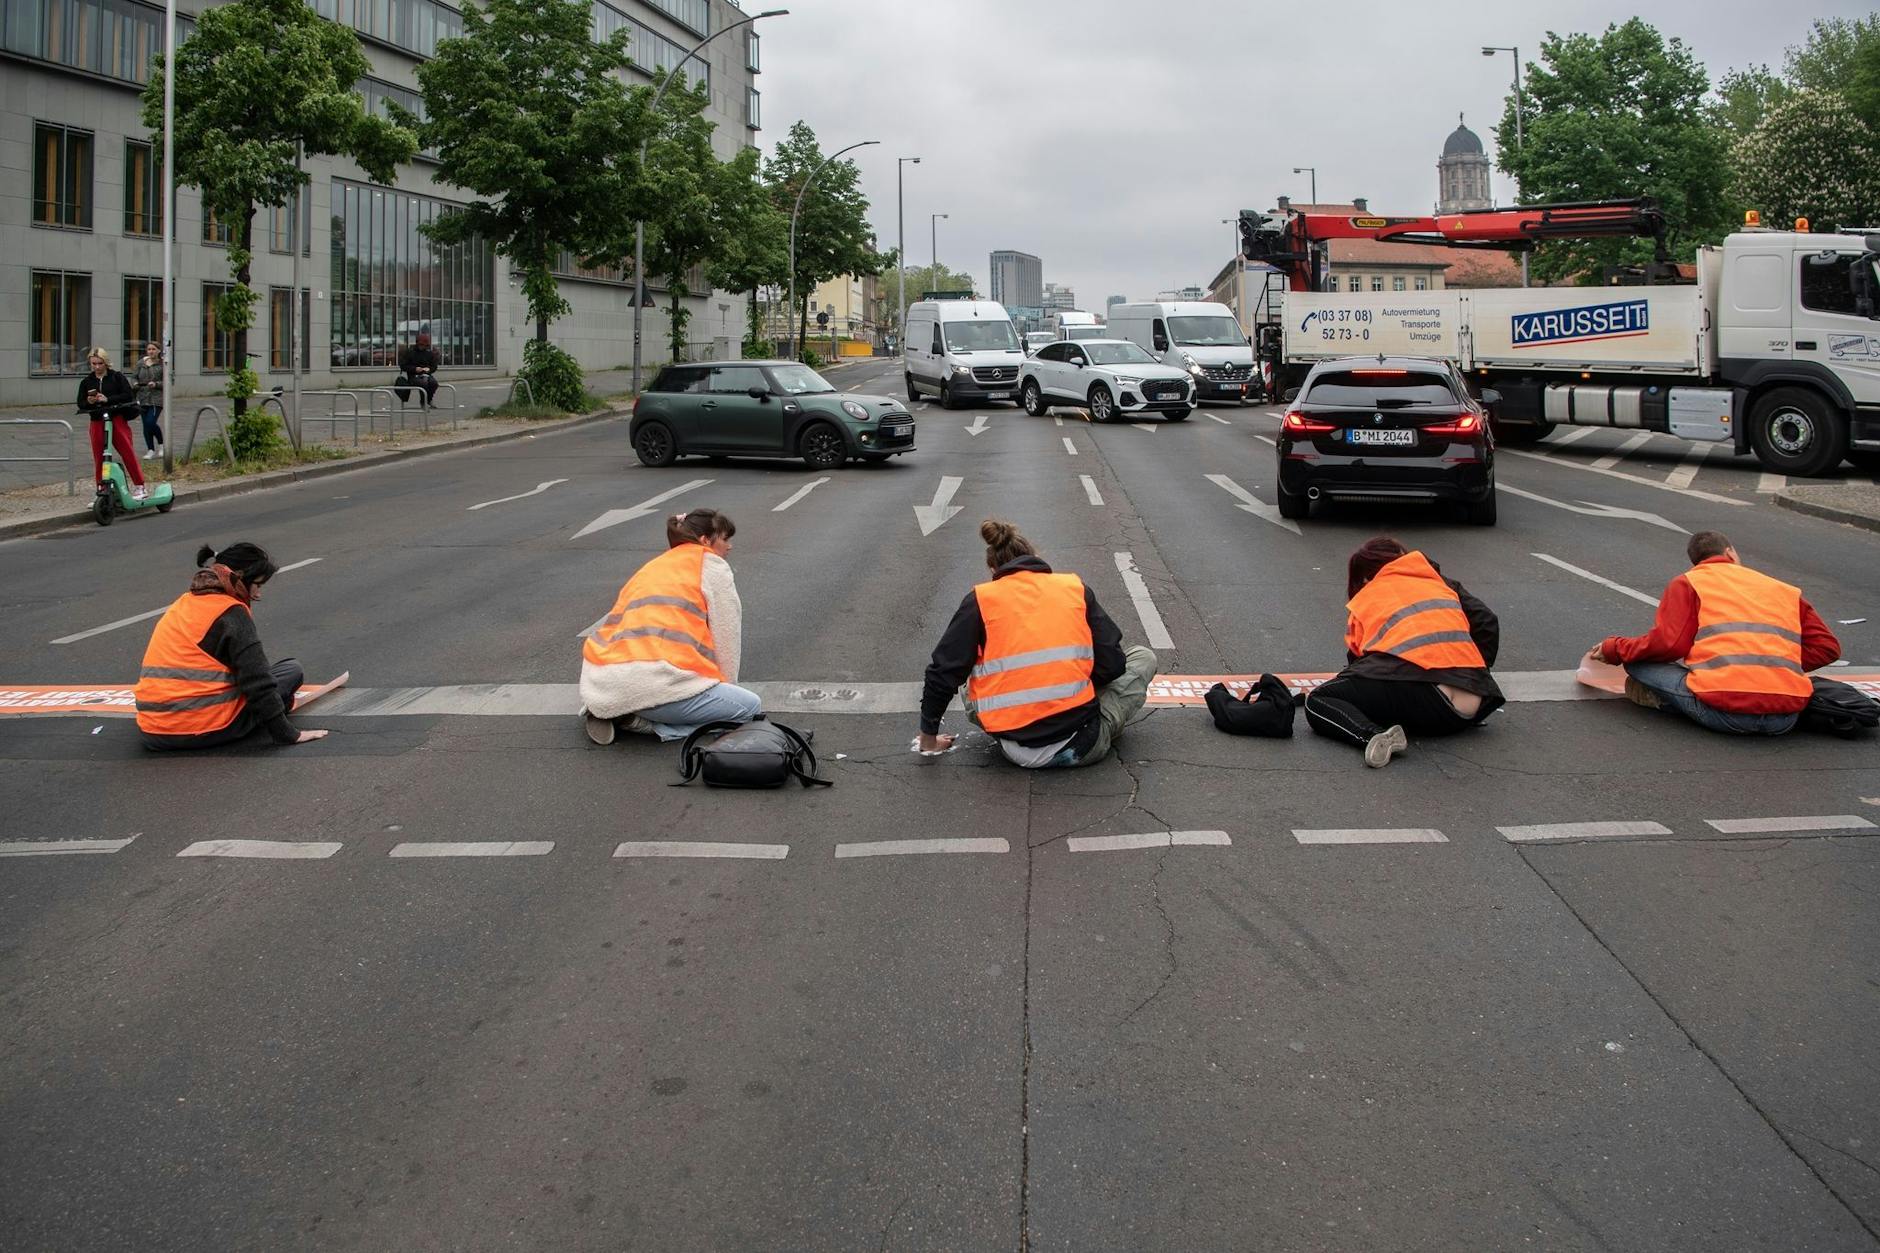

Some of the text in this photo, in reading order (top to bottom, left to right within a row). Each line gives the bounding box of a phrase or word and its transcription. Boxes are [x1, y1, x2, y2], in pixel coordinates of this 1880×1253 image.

[1318, 309, 1373, 324] (03 37 08)
[1381, 308, 1441, 318] Autovermietung
[1401, 320, 1441, 329] Transporte
[1514, 303, 1646, 341] KARUSSEIT
[1322, 328, 1335, 340] 52
[1339, 328, 1352, 340] 73
[1409, 331, 1442, 342] Umzüge
[1353, 431, 1410, 442] B MI 2044
